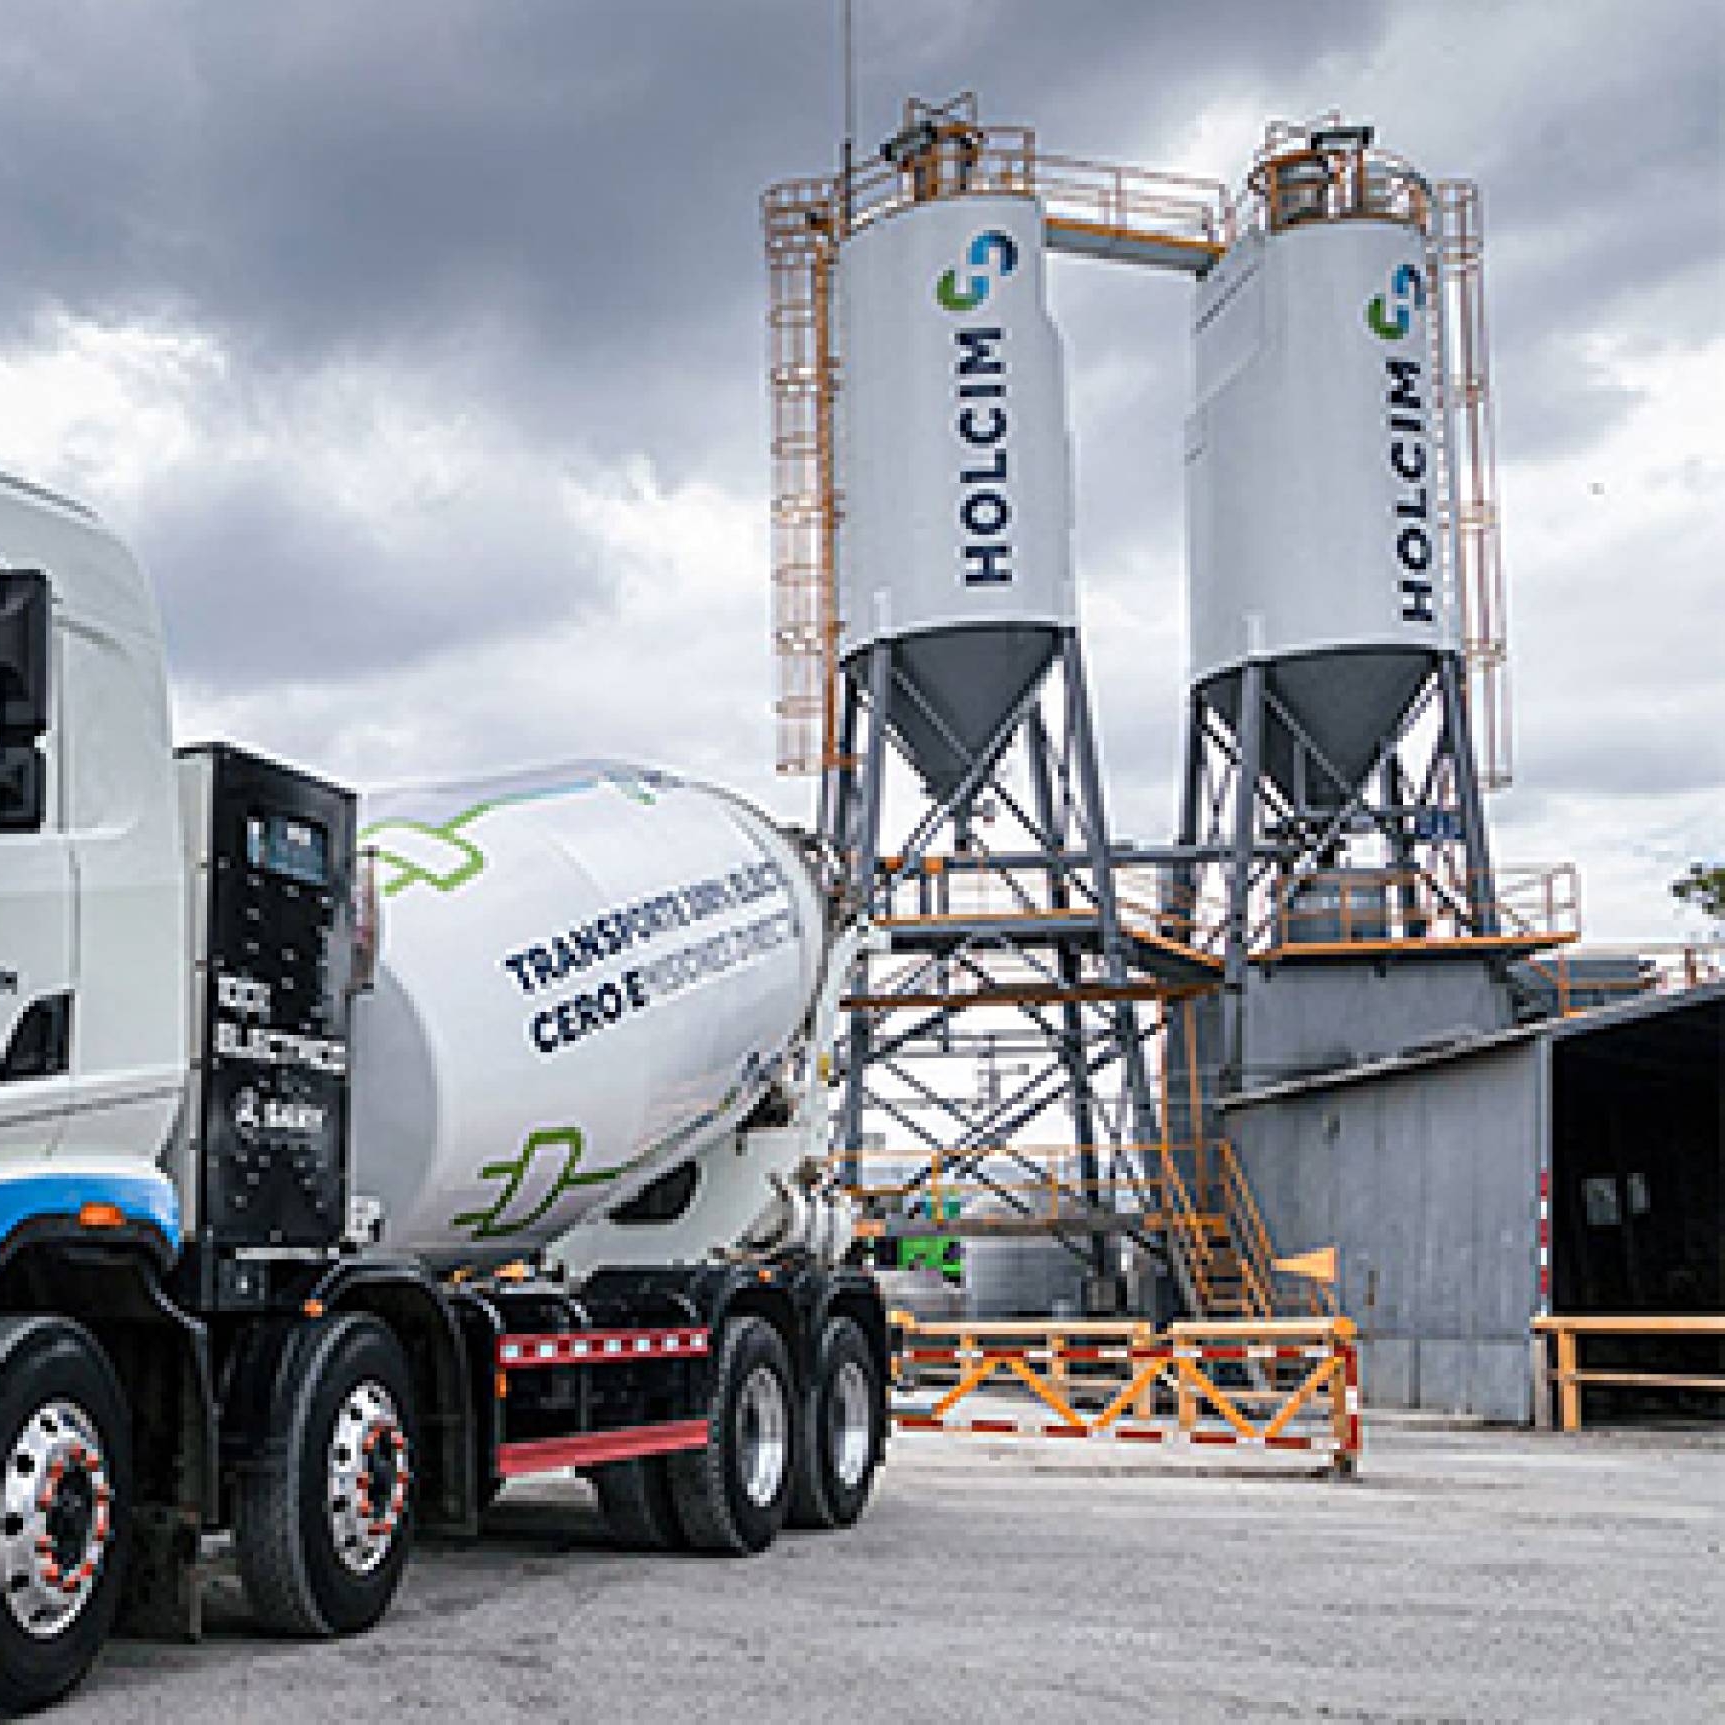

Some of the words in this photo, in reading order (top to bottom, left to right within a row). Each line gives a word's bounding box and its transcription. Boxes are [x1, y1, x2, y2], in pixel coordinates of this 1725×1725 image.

[954, 326, 1013, 587] HOLCIM
[1385, 358, 1433, 622] HOLCIM
[504, 893, 688, 992] TRANSPORTE
[531, 974, 622, 1053] CERO
